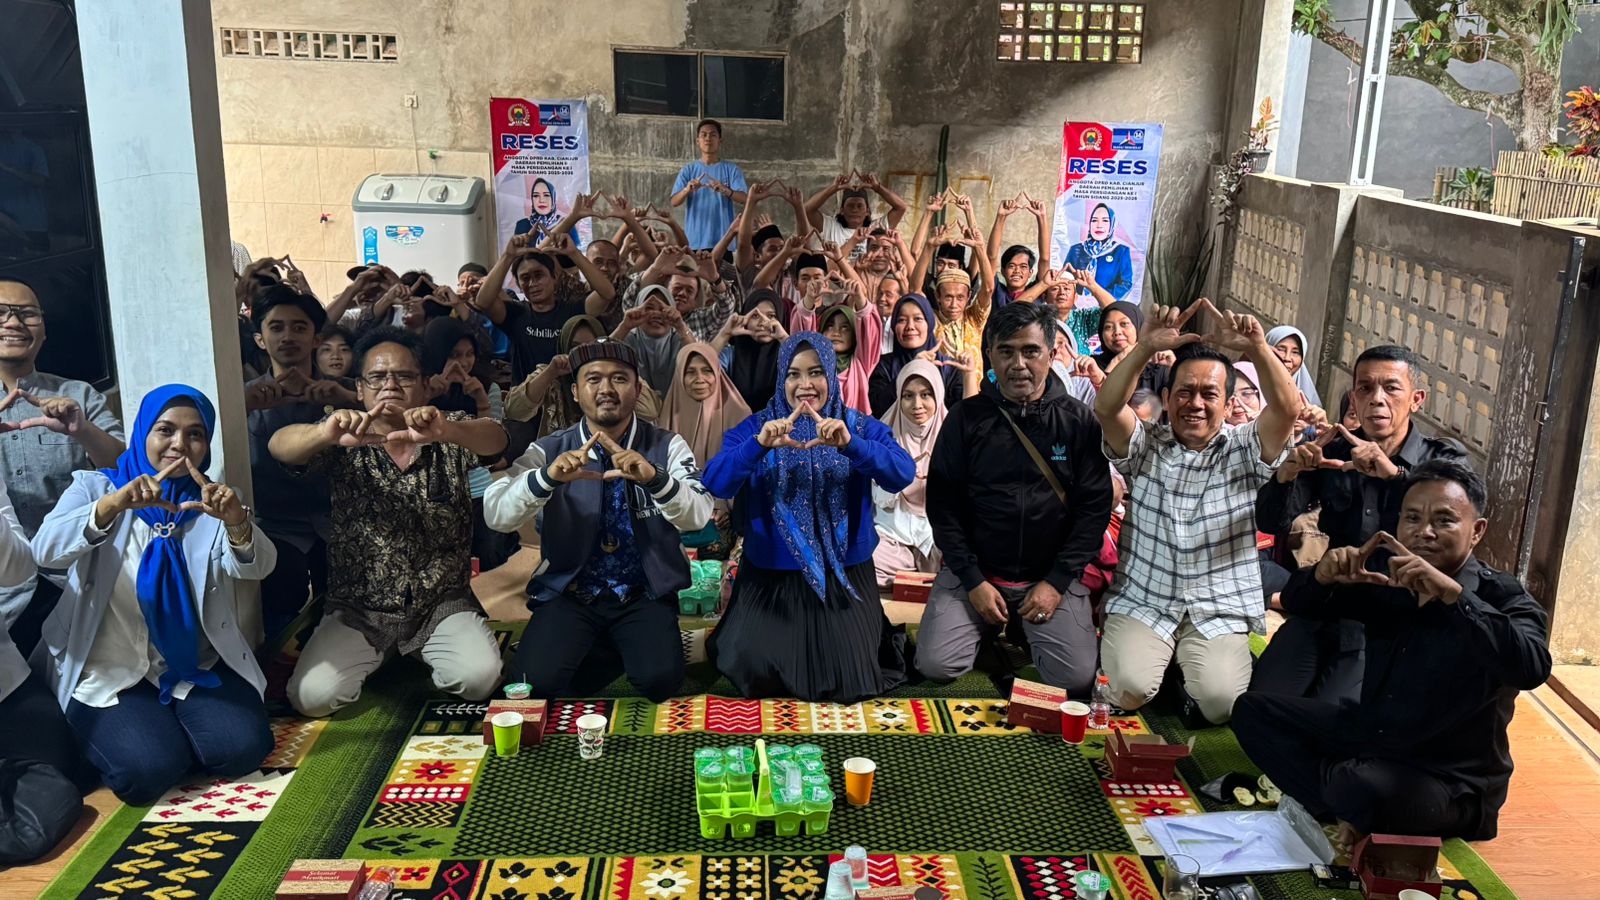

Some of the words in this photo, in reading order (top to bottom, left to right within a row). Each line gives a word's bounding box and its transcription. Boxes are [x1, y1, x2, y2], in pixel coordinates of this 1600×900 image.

[502, 134, 578, 150] RESES
[1069, 159, 1148, 174] RESES
[636, 509, 650, 520] NEW
